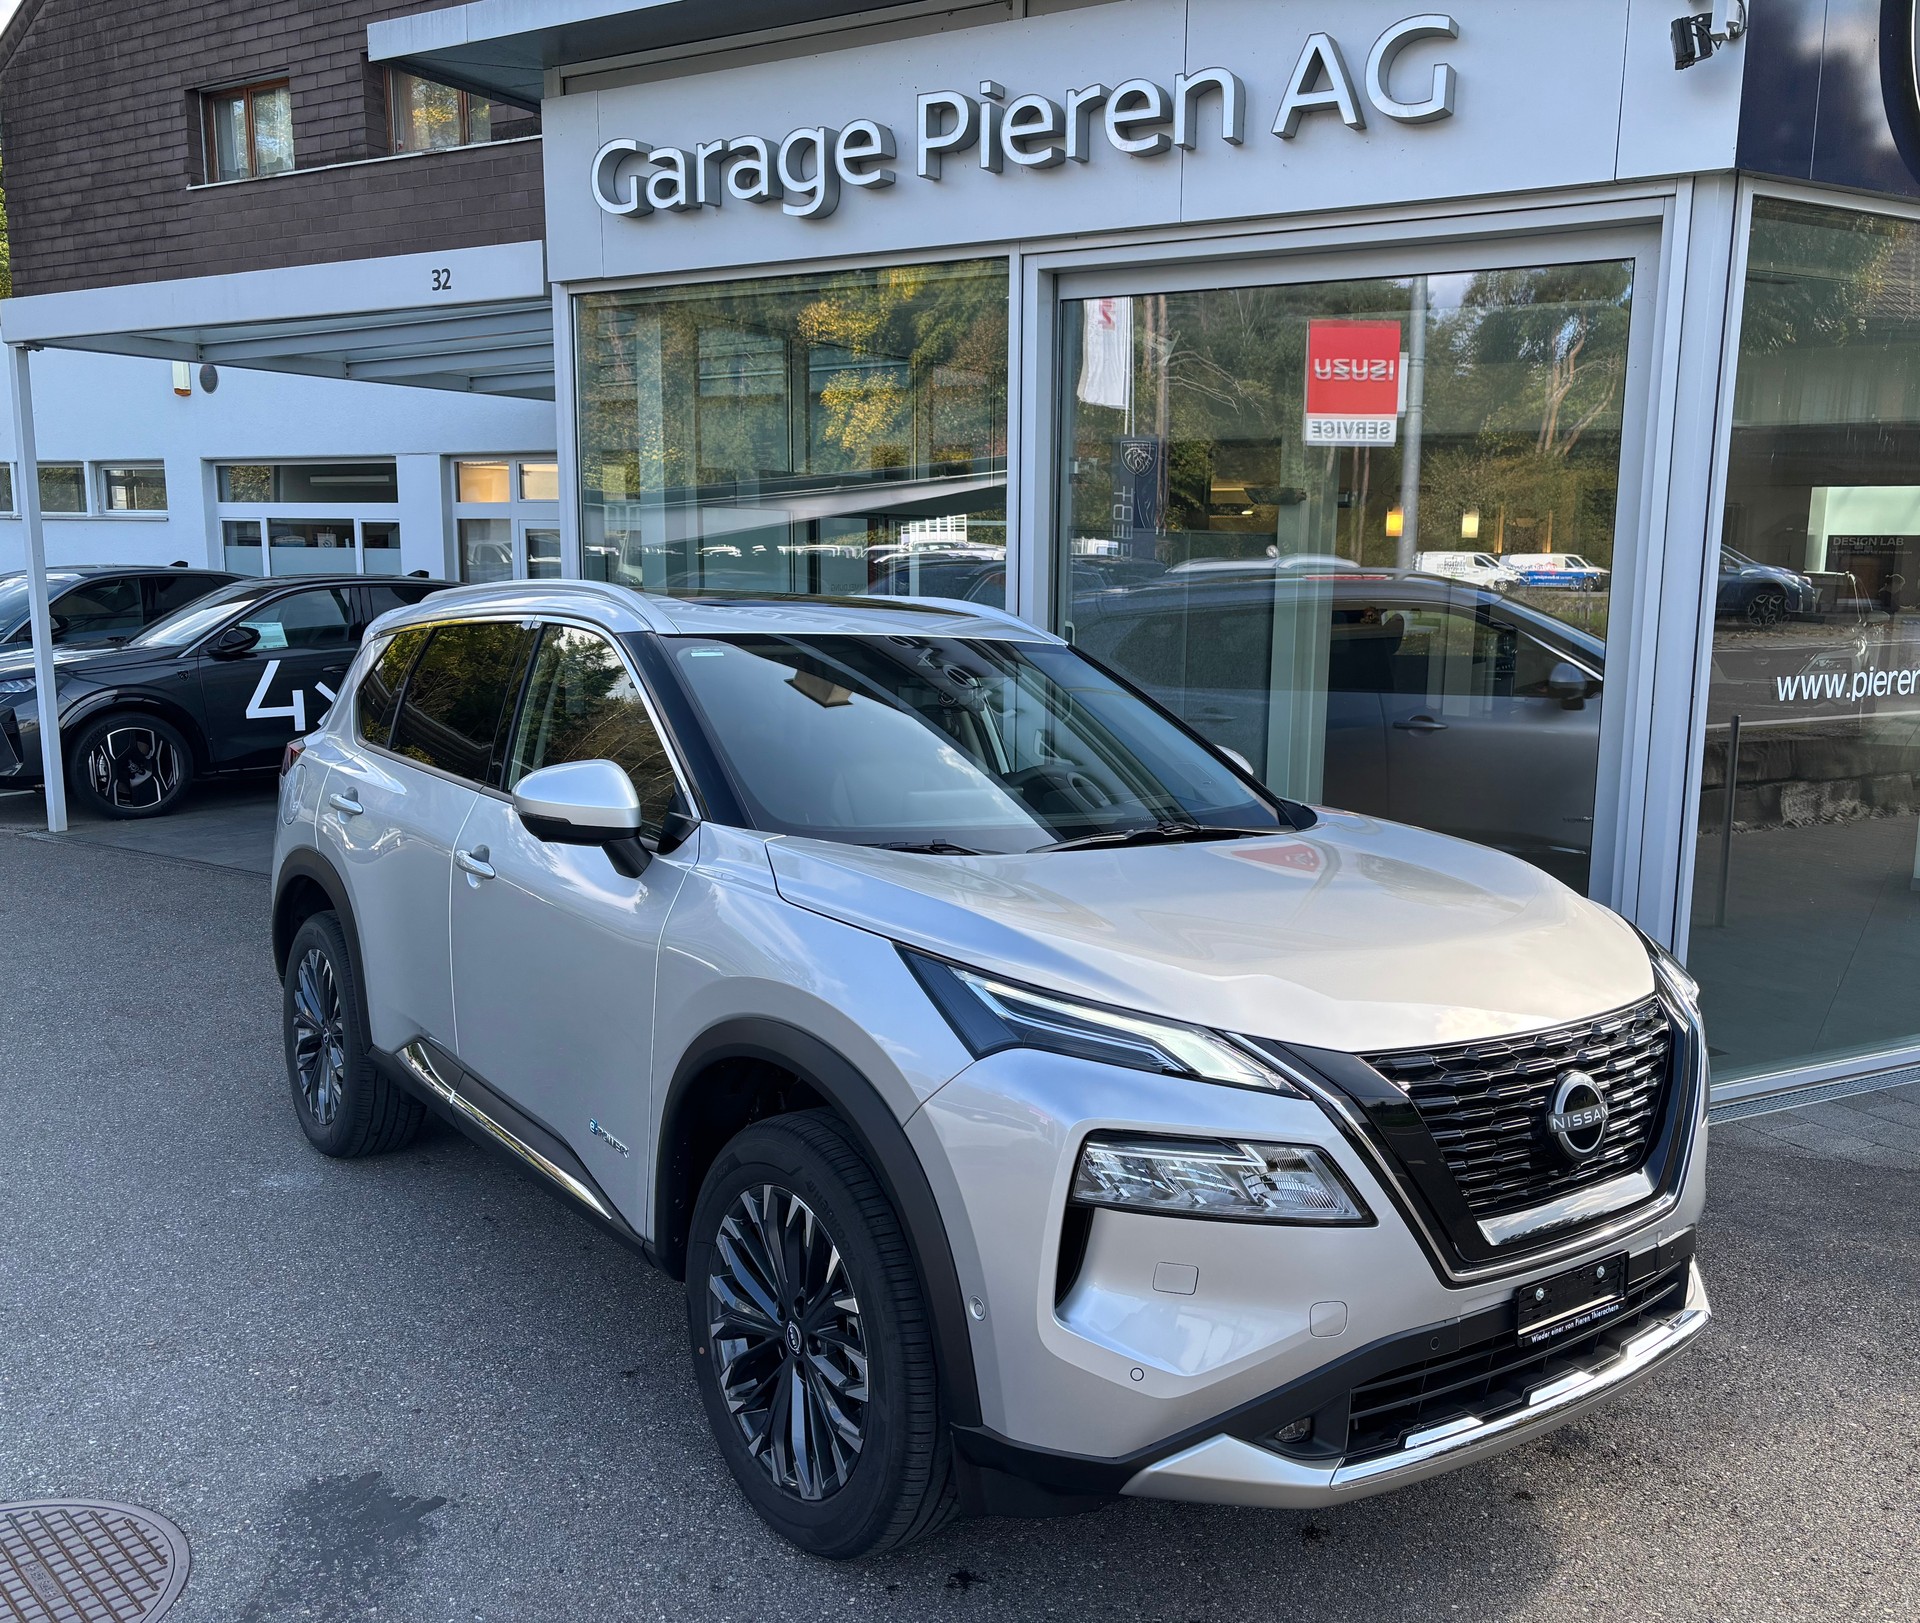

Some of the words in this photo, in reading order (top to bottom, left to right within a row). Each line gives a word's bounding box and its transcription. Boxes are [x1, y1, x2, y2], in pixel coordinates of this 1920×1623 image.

[591, 118, 896, 219] Garage
[916, 67, 1246, 180] Pieren
[1271, 13, 1459, 139] AG
[431, 268, 452, 291] 32
[1832, 536, 1878, 546] DESIGN
[1880, 536, 1905, 546] LAB
[1552, 1104, 1609, 1130] NISSAN
[1531, 1330, 1551, 1343] Wieder
[1551, 1325, 1565, 1336] einer
[1565, 1322, 1575, 1331] von
[1575, 1315, 1591, 1327] Pieren
